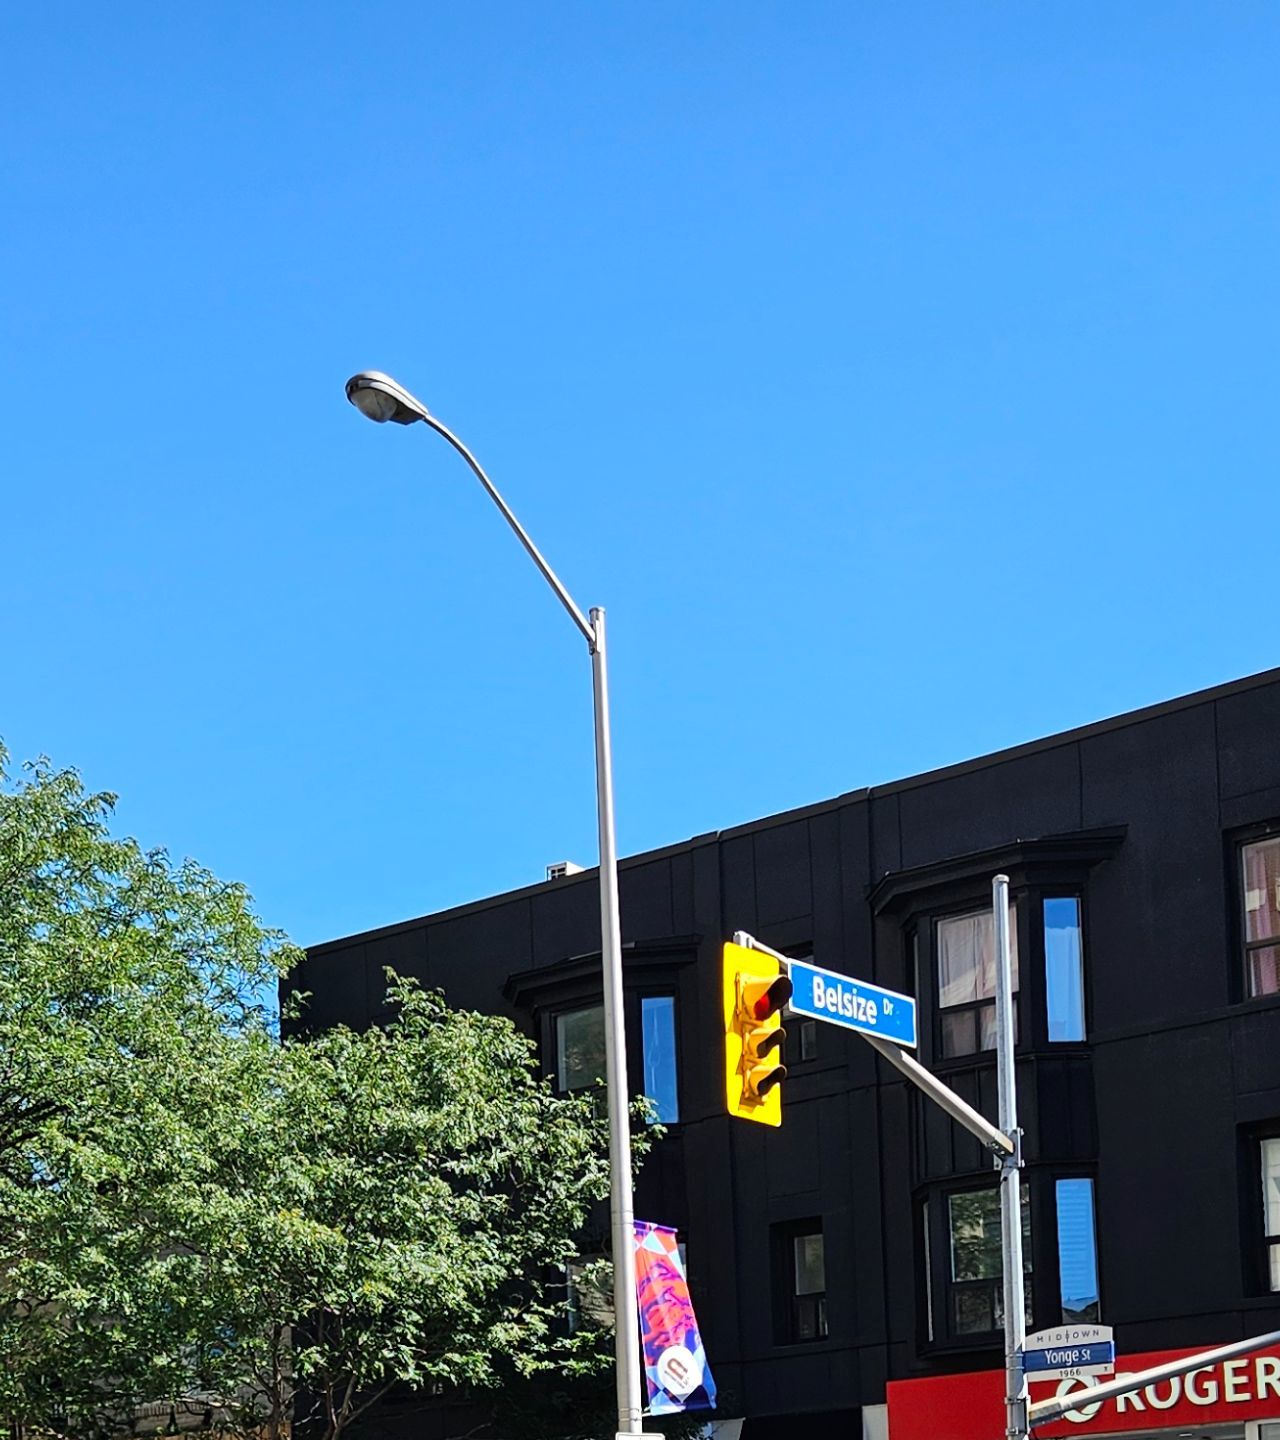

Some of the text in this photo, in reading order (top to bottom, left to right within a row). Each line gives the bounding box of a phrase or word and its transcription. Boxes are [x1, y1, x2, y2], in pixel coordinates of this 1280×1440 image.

[812, 975, 894, 1025] Belsize Dr
[1044, 1348, 1091, 1366] Yonge St
[1059, 1368, 1081, 1378] 1966
